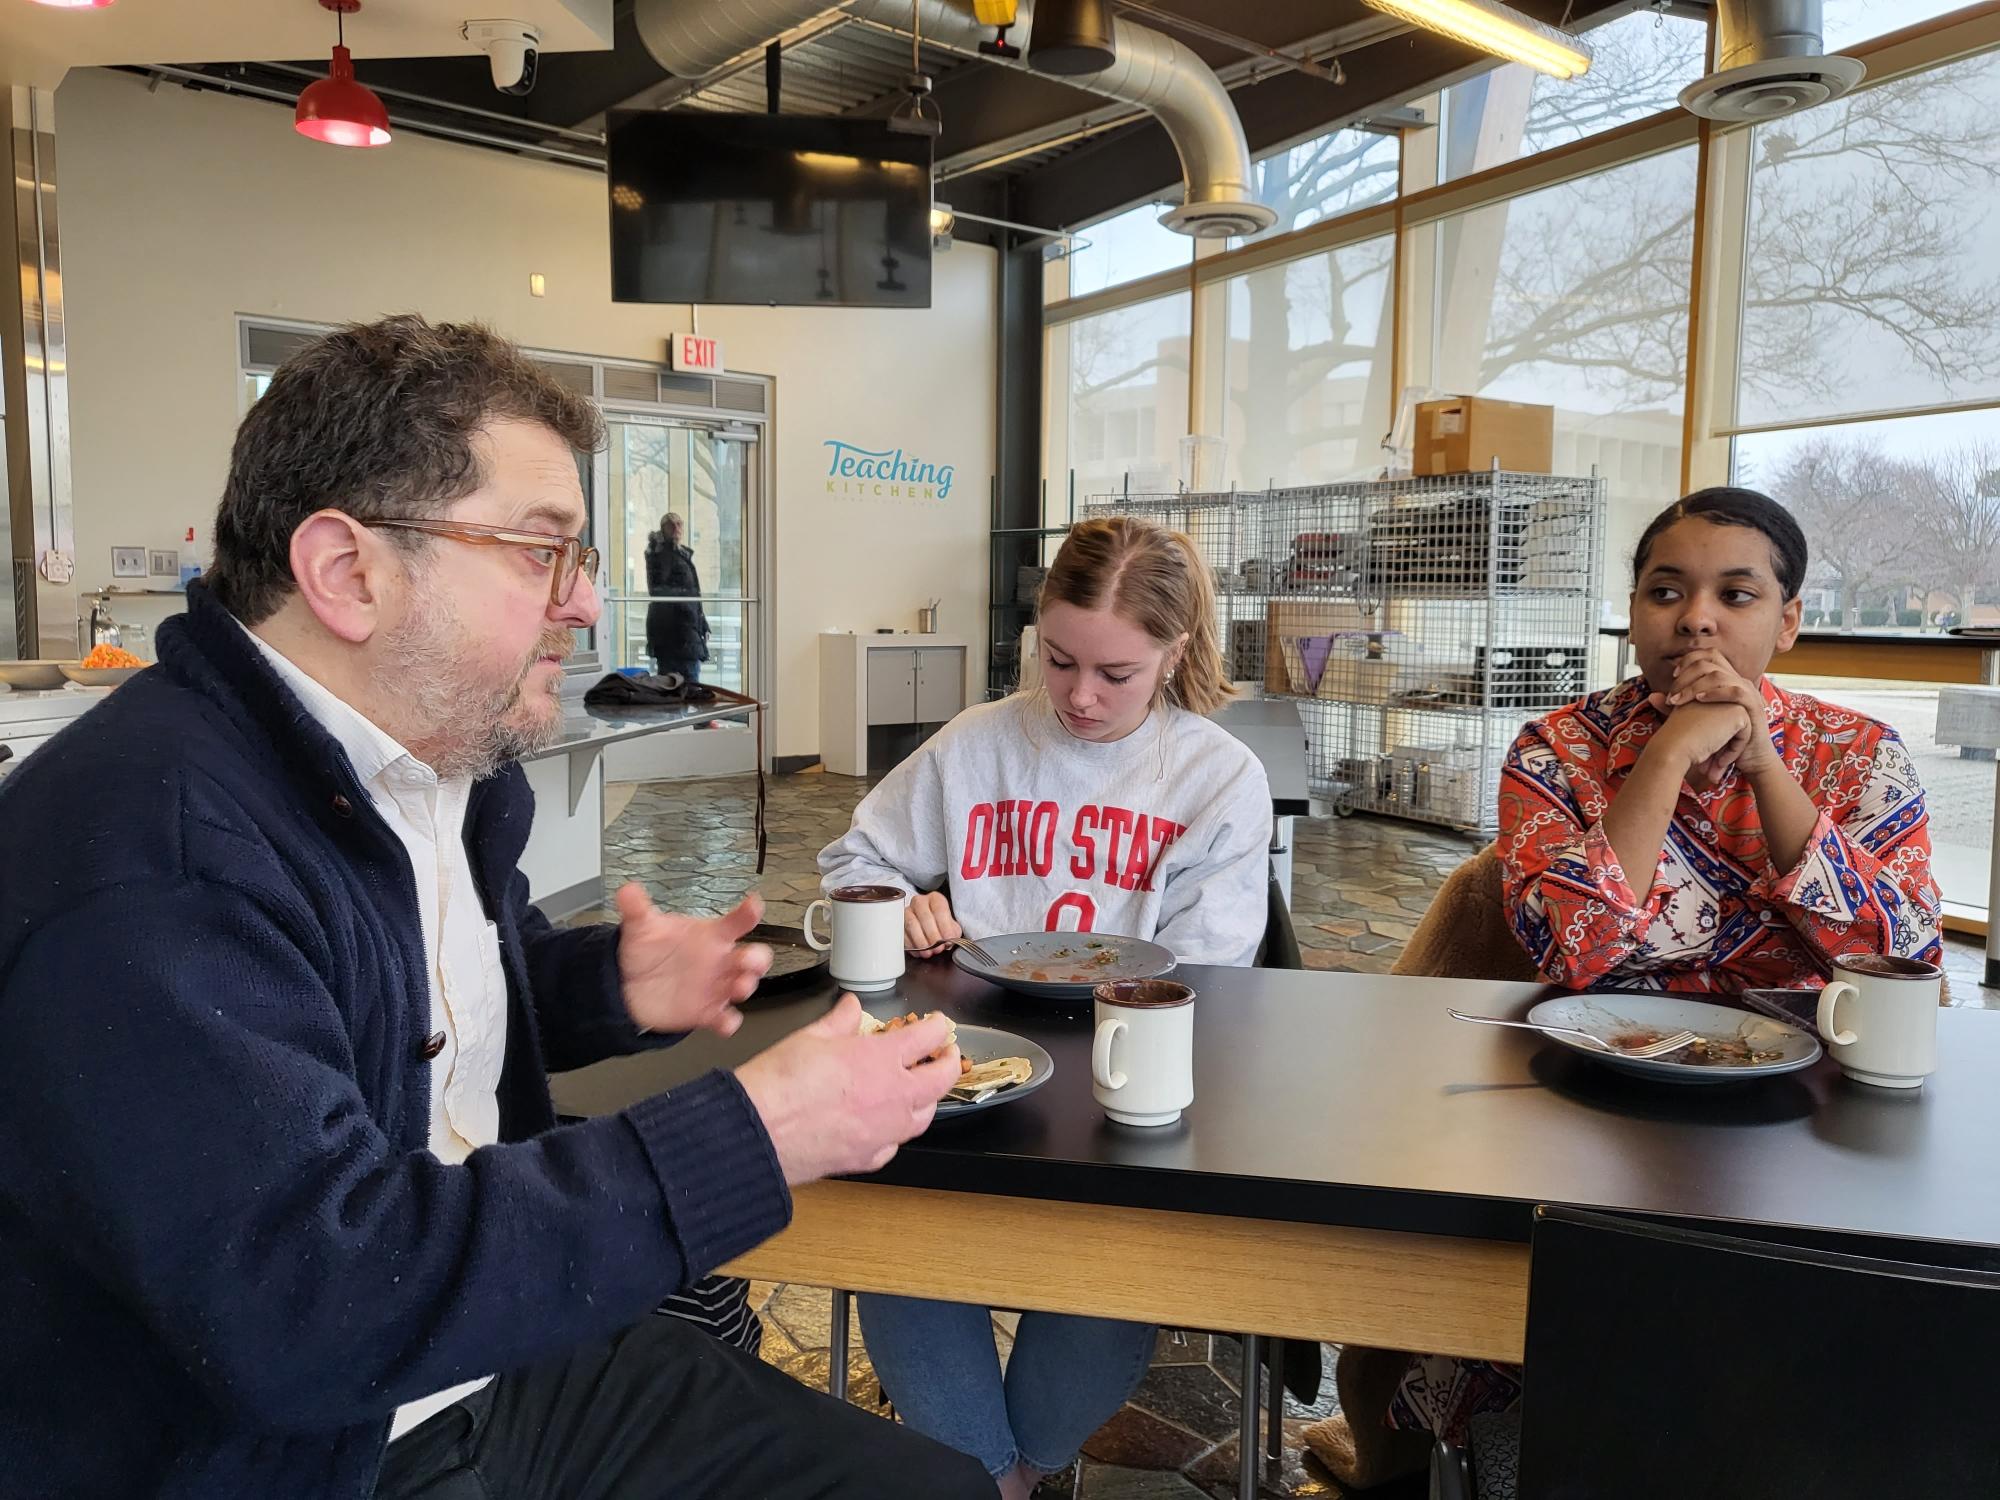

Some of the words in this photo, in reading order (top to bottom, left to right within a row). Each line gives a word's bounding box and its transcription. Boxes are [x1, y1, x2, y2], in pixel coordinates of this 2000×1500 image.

[684, 336, 717, 368] EXIT
[823, 440, 955, 499] Teaching
[826, 481, 932, 498] KITCHEN
[960, 799, 1060, 881] OHIO
[1069, 803, 1188, 893] STAT
